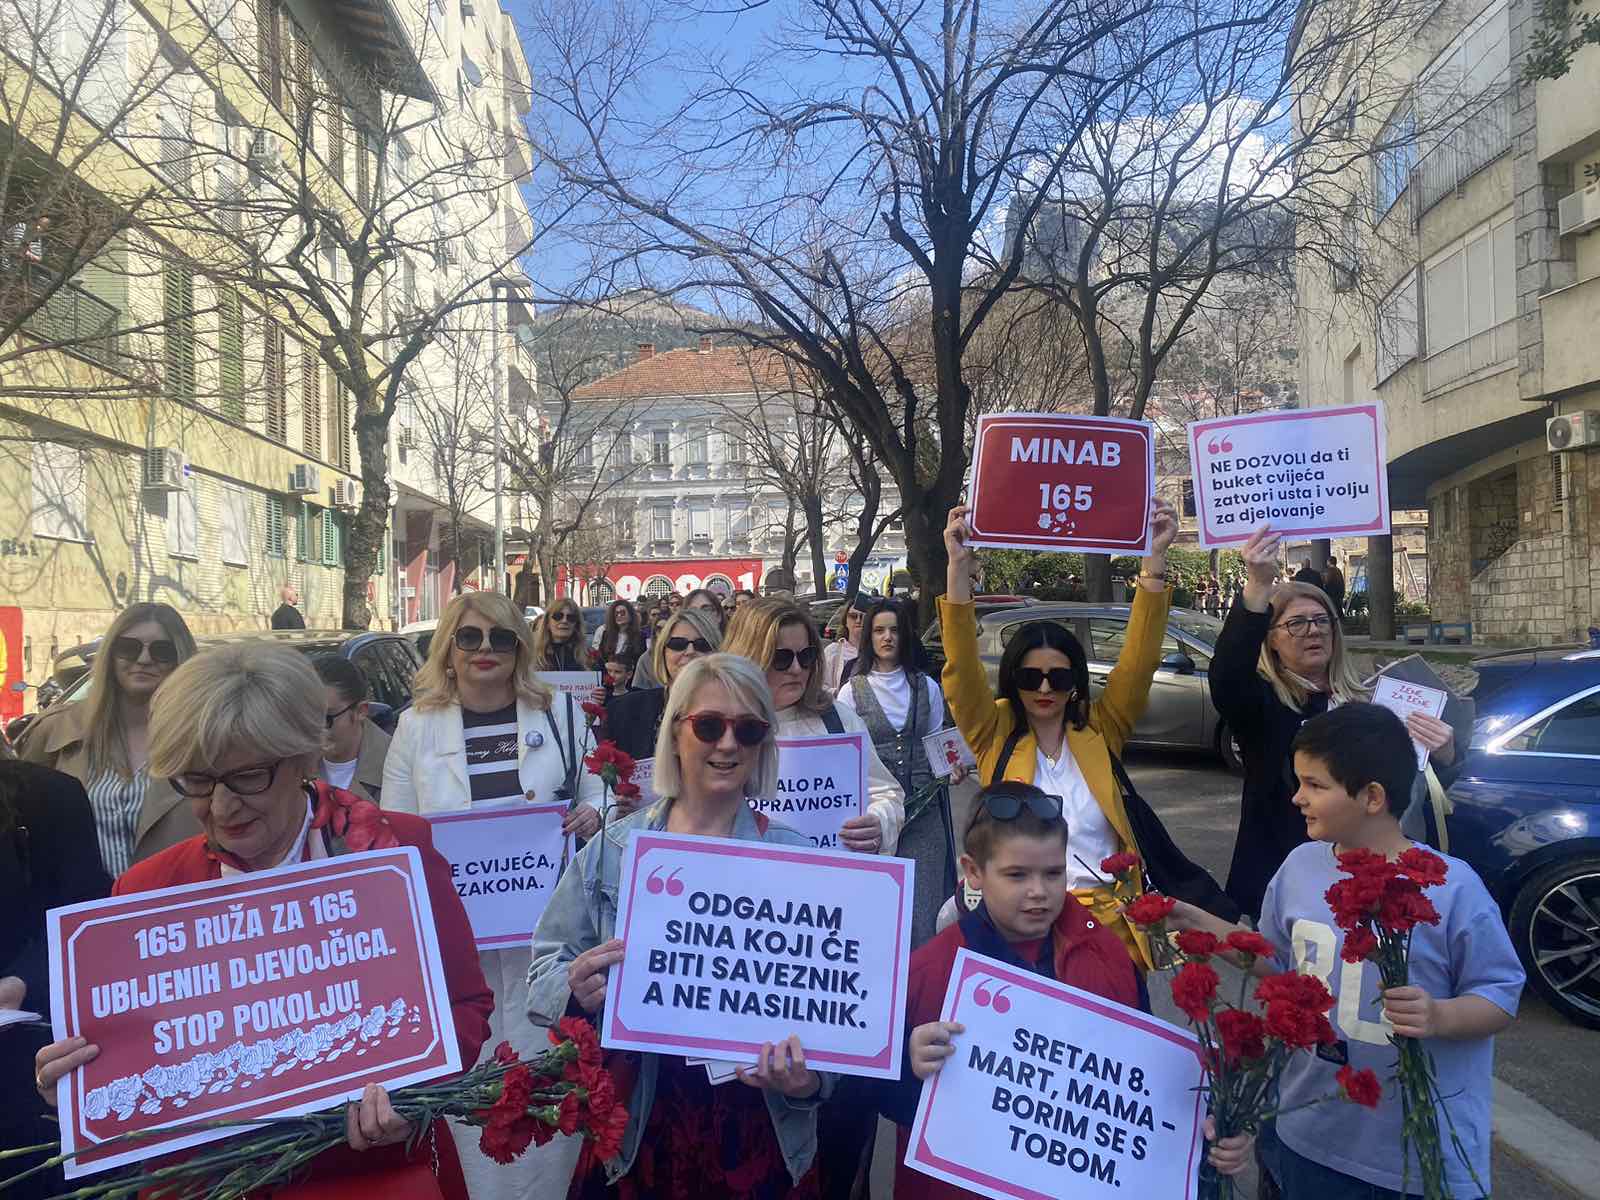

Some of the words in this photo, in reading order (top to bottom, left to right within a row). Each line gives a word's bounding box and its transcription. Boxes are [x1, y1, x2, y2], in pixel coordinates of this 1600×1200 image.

[1010, 437, 1121, 467] MINAB
[1211, 460, 1232, 474] NE
[1236, 451, 1306, 471] DOZVOLI
[1311, 451, 1333, 464] da
[1337, 448, 1350, 462] ti
[1039, 483, 1093, 511] 165
[1212, 473, 1262, 491] buket
[1266, 468, 1325, 487] cvijeća
[1214, 488, 1273, 508] zatvori
[1278, 487, 1312, 501] usta
[1316, 485, 1321, 498] i
[1325, 481, 1369, 500] volju
[1216, 512, 1235, 525] za
[1239, 502, 1325, 524] djelovanje
[747, 794, 857, 812] OPRAVNOST.
[776, 778, 809, 793] ALO
[813, 776, 835, 791] PA
[452, 863, 460, 877] E
[465, 851, 555, 876] CVIJEĆA,
[456, 876, 544, 897] ZAKONA.
[134, 921, 187, 960] 165
[195, 903, 264, 949] RUŽA
[271, 900, 305, 934] ZA
[310, 889, 358, 925] 165
[688, 891, 843, 931] ODGAJAM
[665, 919, 736, 950] SINA
[743, 928, 813, 959] KOJI
[821, 930, 860, 964] ĆE
[91, 961, 221, 1018] UBIJENIH
[229, 927, 397, 990] DJEVOJČICA.
[648, 949, 704, 978] BITI
[711, 955, 868, 1001] SAVEZNIK,
[153, 1010, 225, 1055] STOP
[233, 979, 362, 1037] POKOLJU!
[642, 981, 664, 1007] A
[672, 983, 712, 1011] NE
[718, 988, 867, 1029] NASILNIK.
[1012, 1027, 1123, 1086] SRETAN
[1128, 1066, 1151, 1097] 8.
[968, 1045, 1059, 1100] MART,
[1066, 1077, 1154, 1132] MAMA
[991, 1086, 1089, 1140] BORIM
[1094, 1122, 1128, 1154] SE
[1131, 1135, 1147, 1161] S
[1008, 1124, 1121, 1188] TOBOM.
